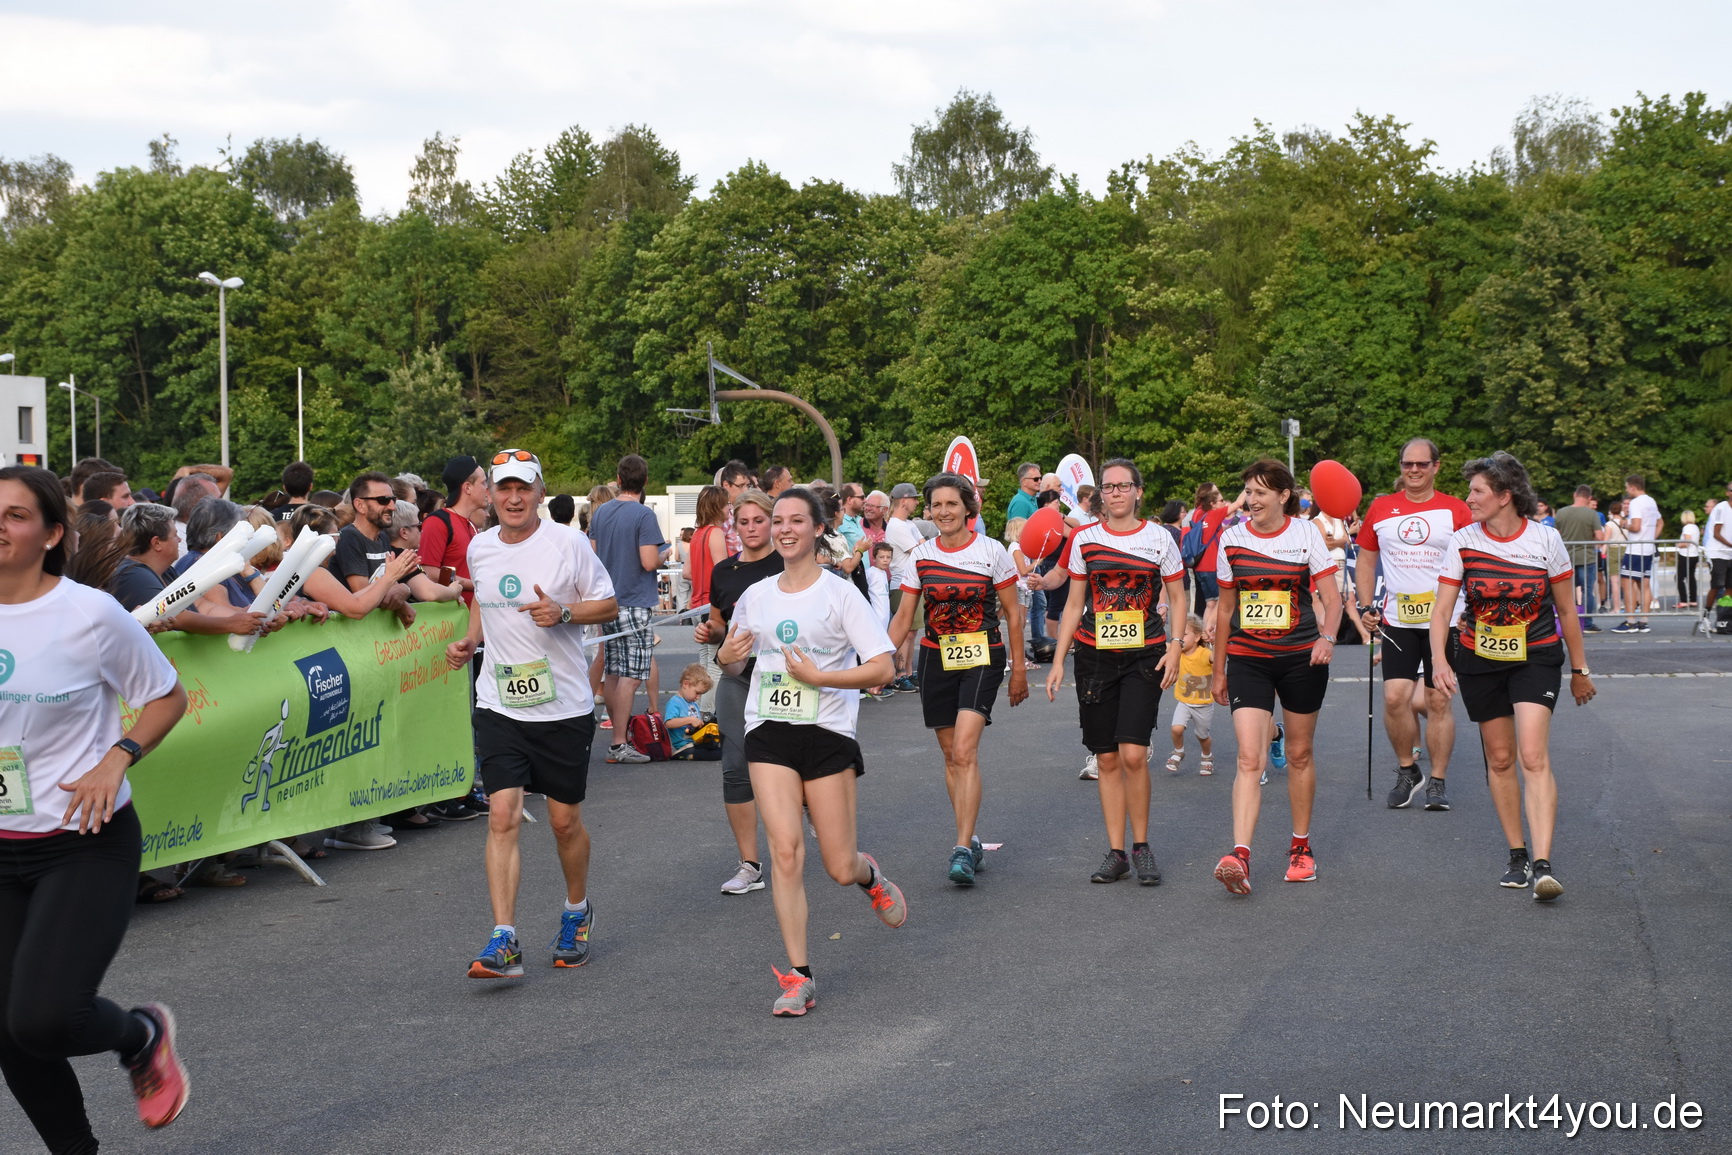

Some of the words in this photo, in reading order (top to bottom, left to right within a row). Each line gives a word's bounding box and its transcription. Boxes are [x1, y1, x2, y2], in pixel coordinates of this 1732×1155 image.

[1246, 604, 1283, 618] 2270
[1401, 602, 1431, 615] 1907
[1101, 623, 1138, 638] 2258
[374, 630, 423, 666] Gesunde
[419, 620, 455, 648] Firmen
[946, 644, 982, 660] 2253
[1480, 635, 1519, 651] 2256
[315, 673, 343, 694] Fischer
[400, 658, 428, 695] laufen
[506, 677, 539, 695] 460
[36, 692, 70, 704] GmbH
[769, 689, 802, 707] 461
[279, 699, 385, 784] firmenlauf
[277, 769, 325, 803] neumarkt
[349, 760, 466, 807] www.firmenlauf-oberpfalz.de
